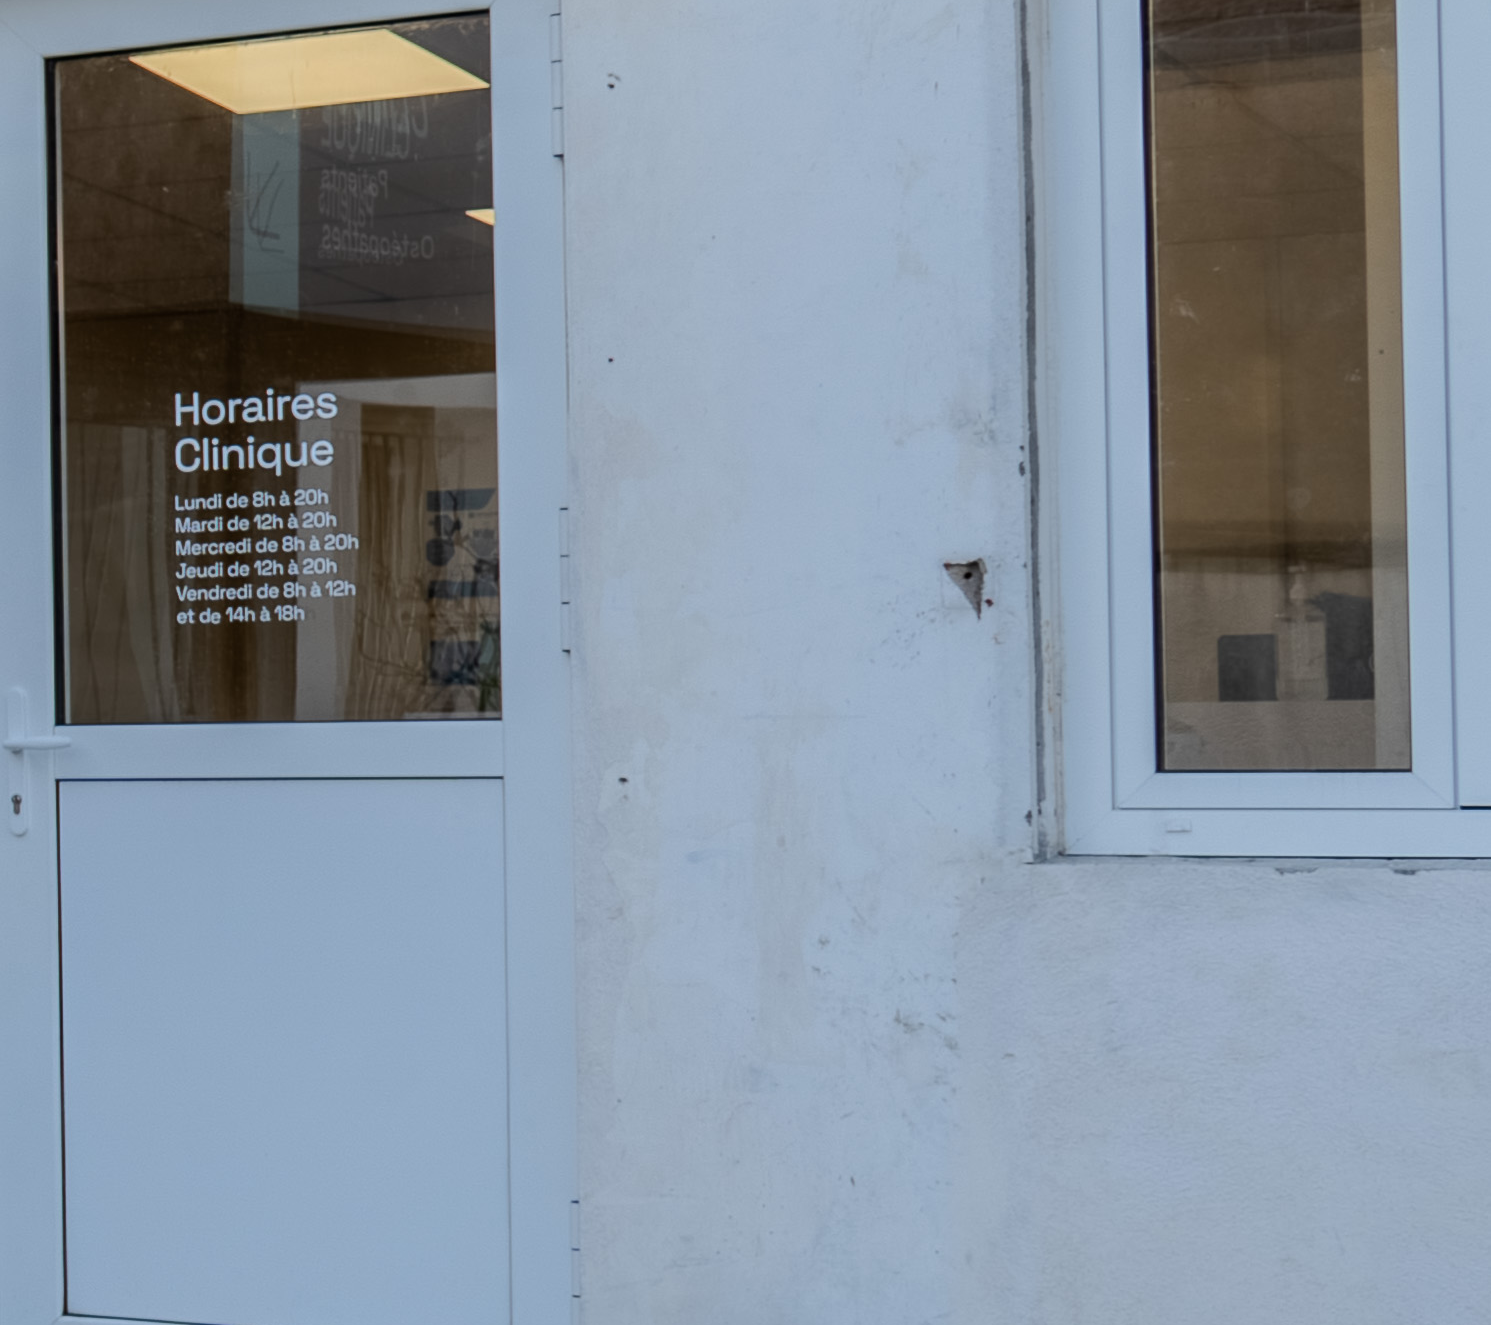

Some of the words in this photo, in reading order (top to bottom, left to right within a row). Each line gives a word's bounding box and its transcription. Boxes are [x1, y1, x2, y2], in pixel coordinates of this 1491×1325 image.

[175, 388, 338, 426] Horaires
[175, 435, 334, 476] Clinique
[174, 493, 222, 511] Lundi
[226, 492, 248, 508] de
[252, 491, 275, 507] 8h
[279, 490, 291, 506] à
[294, 489, 328, 506] 20h
[175, 516, 223, 533] Mardi
[227, 515, 250, 531] de
[253, 513, 283, 530] 12h
[287, 512, 299, 529] à
[302, 511, 337, 528] 20h
[175, 537, 251, 556] Mercredi
[255, 537, 278, 552] de
[282, 536, 305, 552] 8h
[309, 535, 320, 551] à
[324, 534, 359, 551] 20h
[175, 561, 223, 579] Jeudi
[227, 561, 250, 577] de
[253, 559, 284, 576] 12h
[288, 559, 299, 575] à
[302, 557, 338, 575] 20h
[175, 584, 252, 602] Vendredi
[256, 583, 279, 599] de
[283, 581, 306, 598] 8h
[310, 581, 322, 598] à
[325, 580, 356, 597] 12h
[176, 609, 195, 625] et
[199, 607, 221, 624] de
[225, 606, 256, 622] 14h
[260, 606, 271, 622] à
[274, 604, 305, 621] 18h
